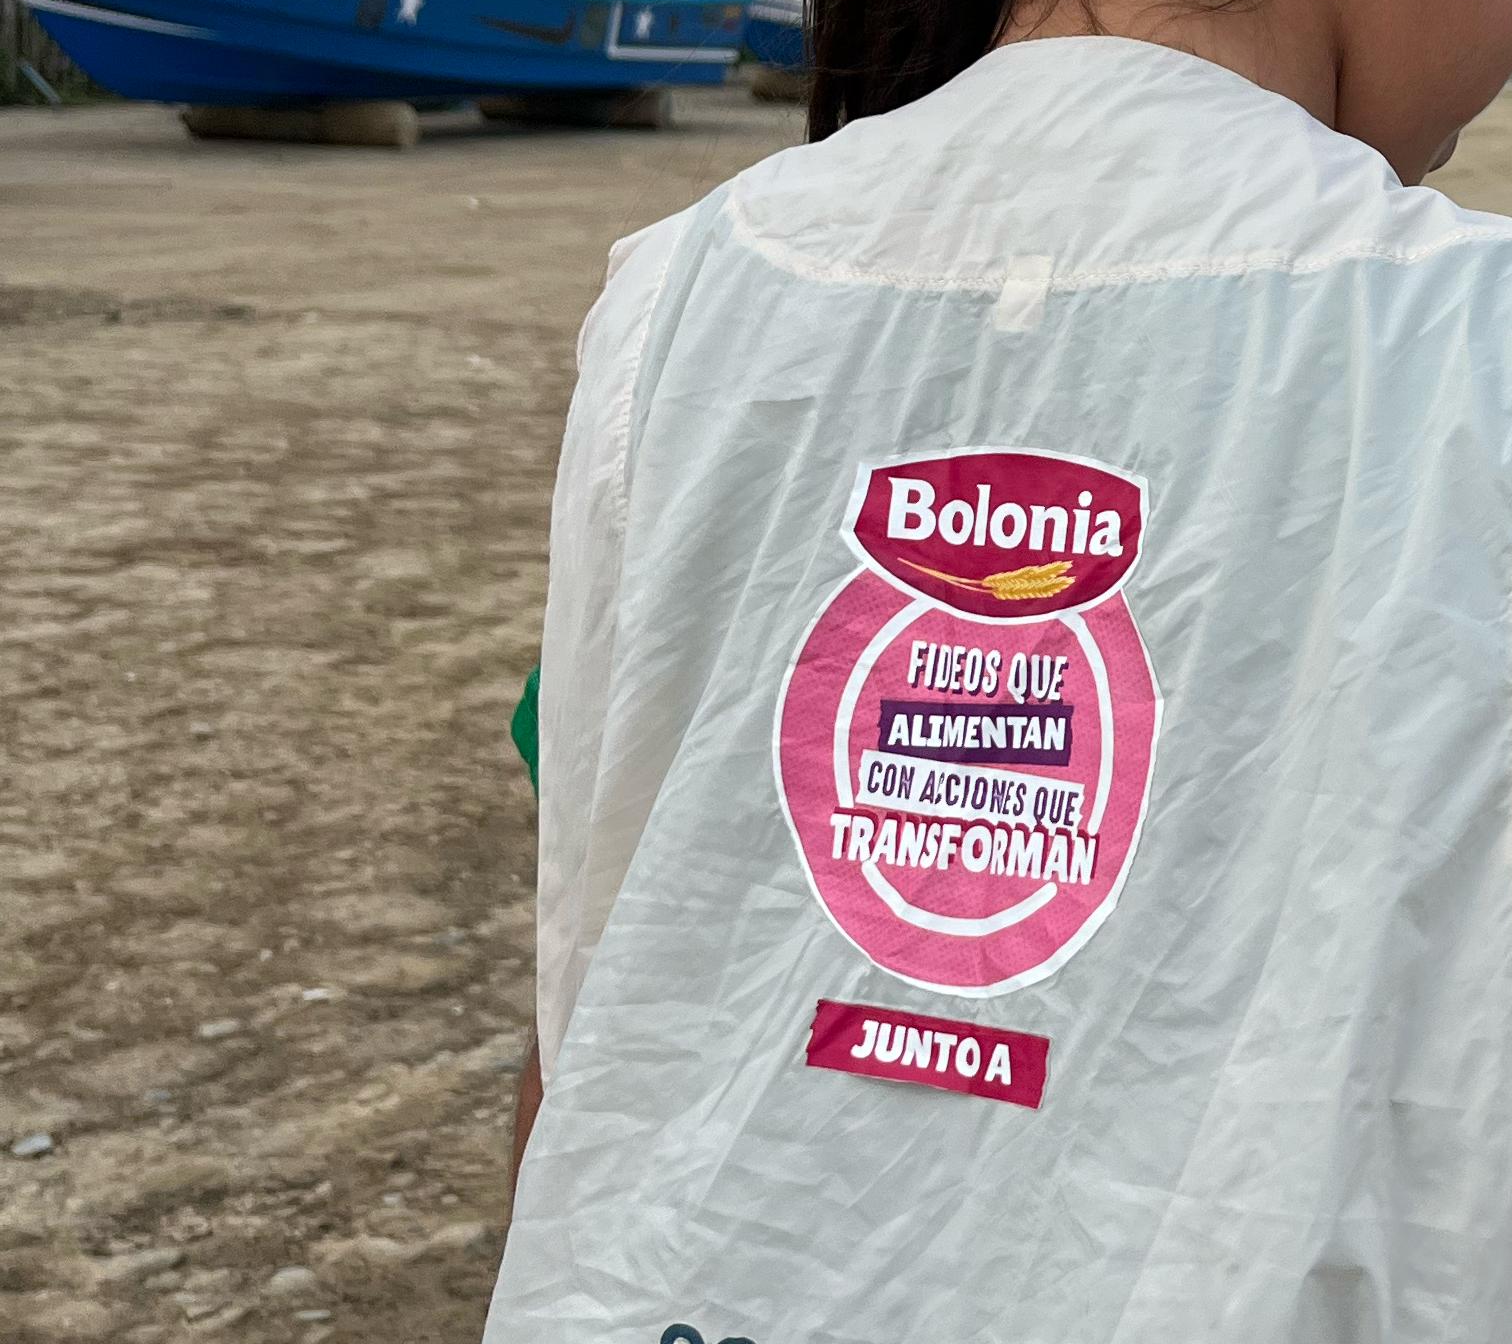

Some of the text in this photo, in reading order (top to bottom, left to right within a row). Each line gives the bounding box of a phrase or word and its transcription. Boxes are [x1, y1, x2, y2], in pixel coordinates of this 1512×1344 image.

[887, 476, 1123, 556] Bolonia
[907, 640, 1069, 705] FIDEOS QUE
[888, 713, 1066, 751] ALIMENTAN
[867, 760, 915, 800] CON
[1033, 786, 1080, 827] QUE
[830, 813, 1097, 885] TRANSFORMAN
